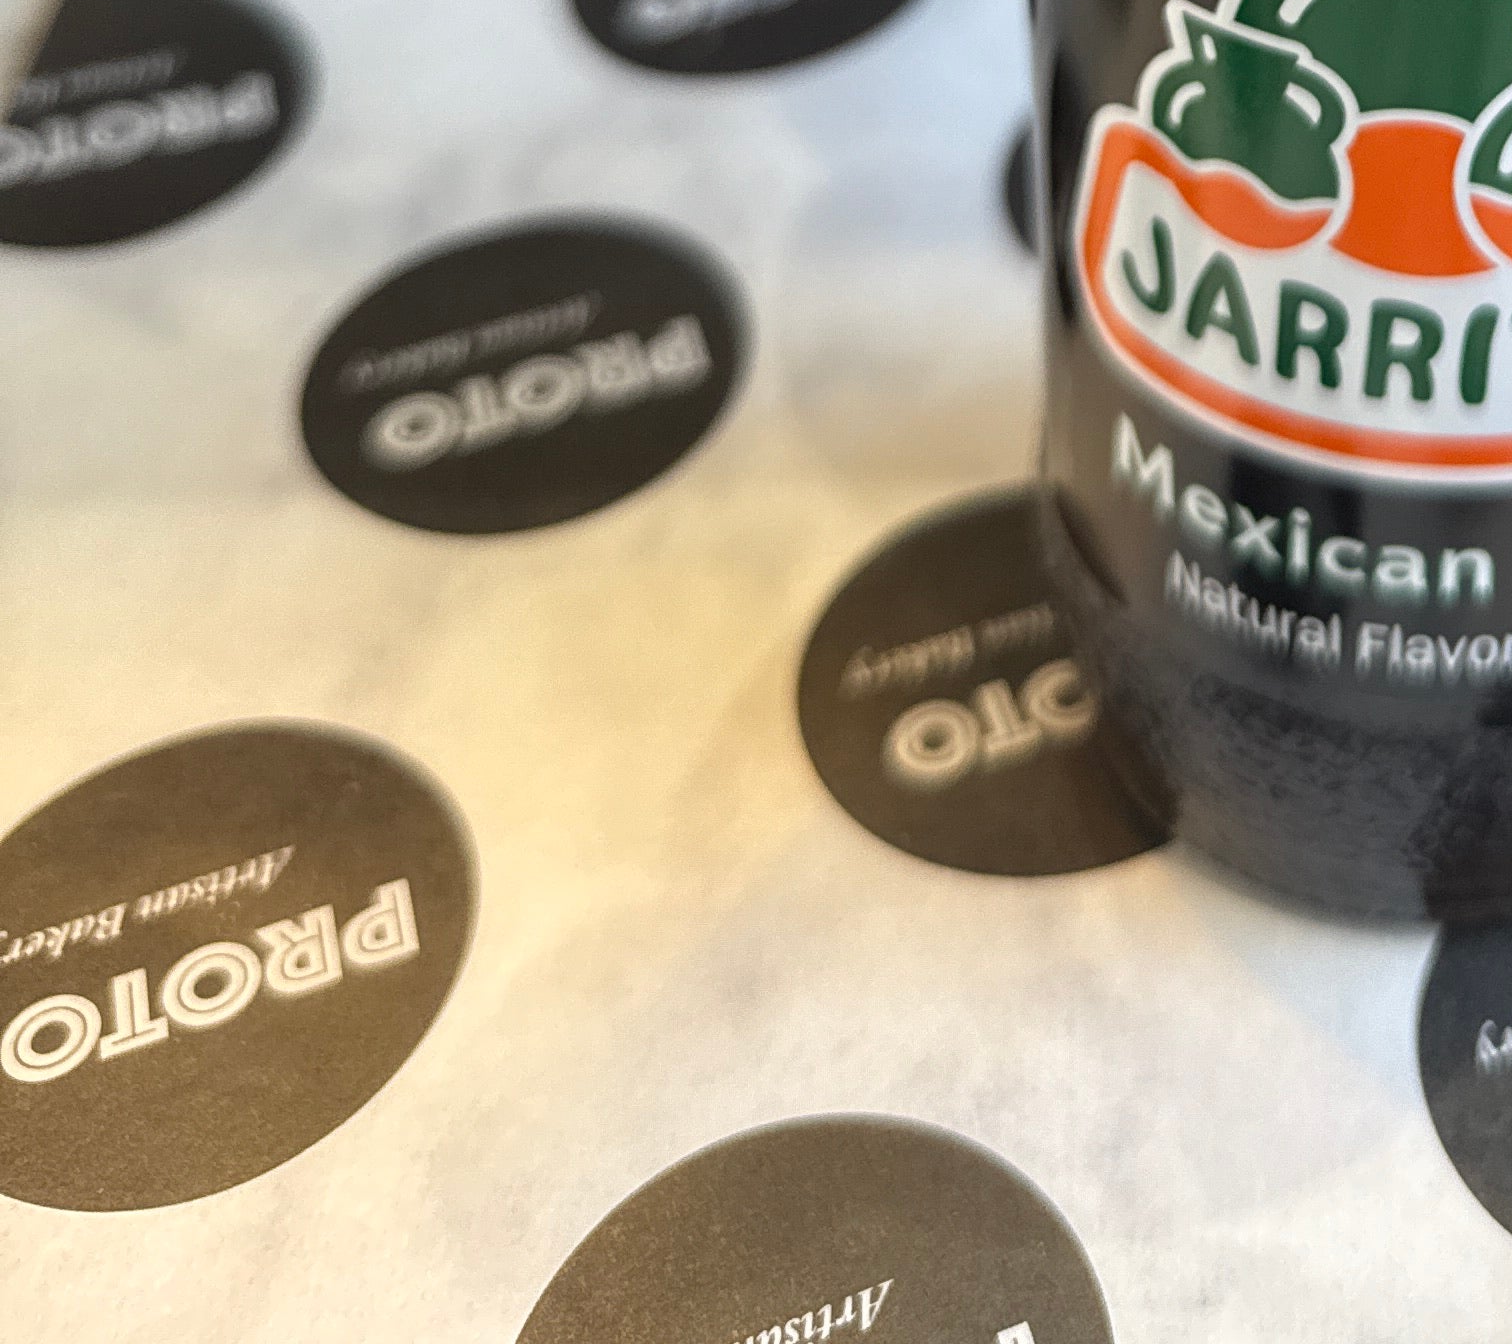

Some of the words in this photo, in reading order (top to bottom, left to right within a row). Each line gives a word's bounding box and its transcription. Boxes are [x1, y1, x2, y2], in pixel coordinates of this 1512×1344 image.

[362, 314, 712, 469] PROTO
[1113, 412, 1494, 602] Mexican
[1166, 548, 1342, 658] Natural
[132, 844, 297, 919] Artisan
[0, 876, 421, 1083] PROTO
